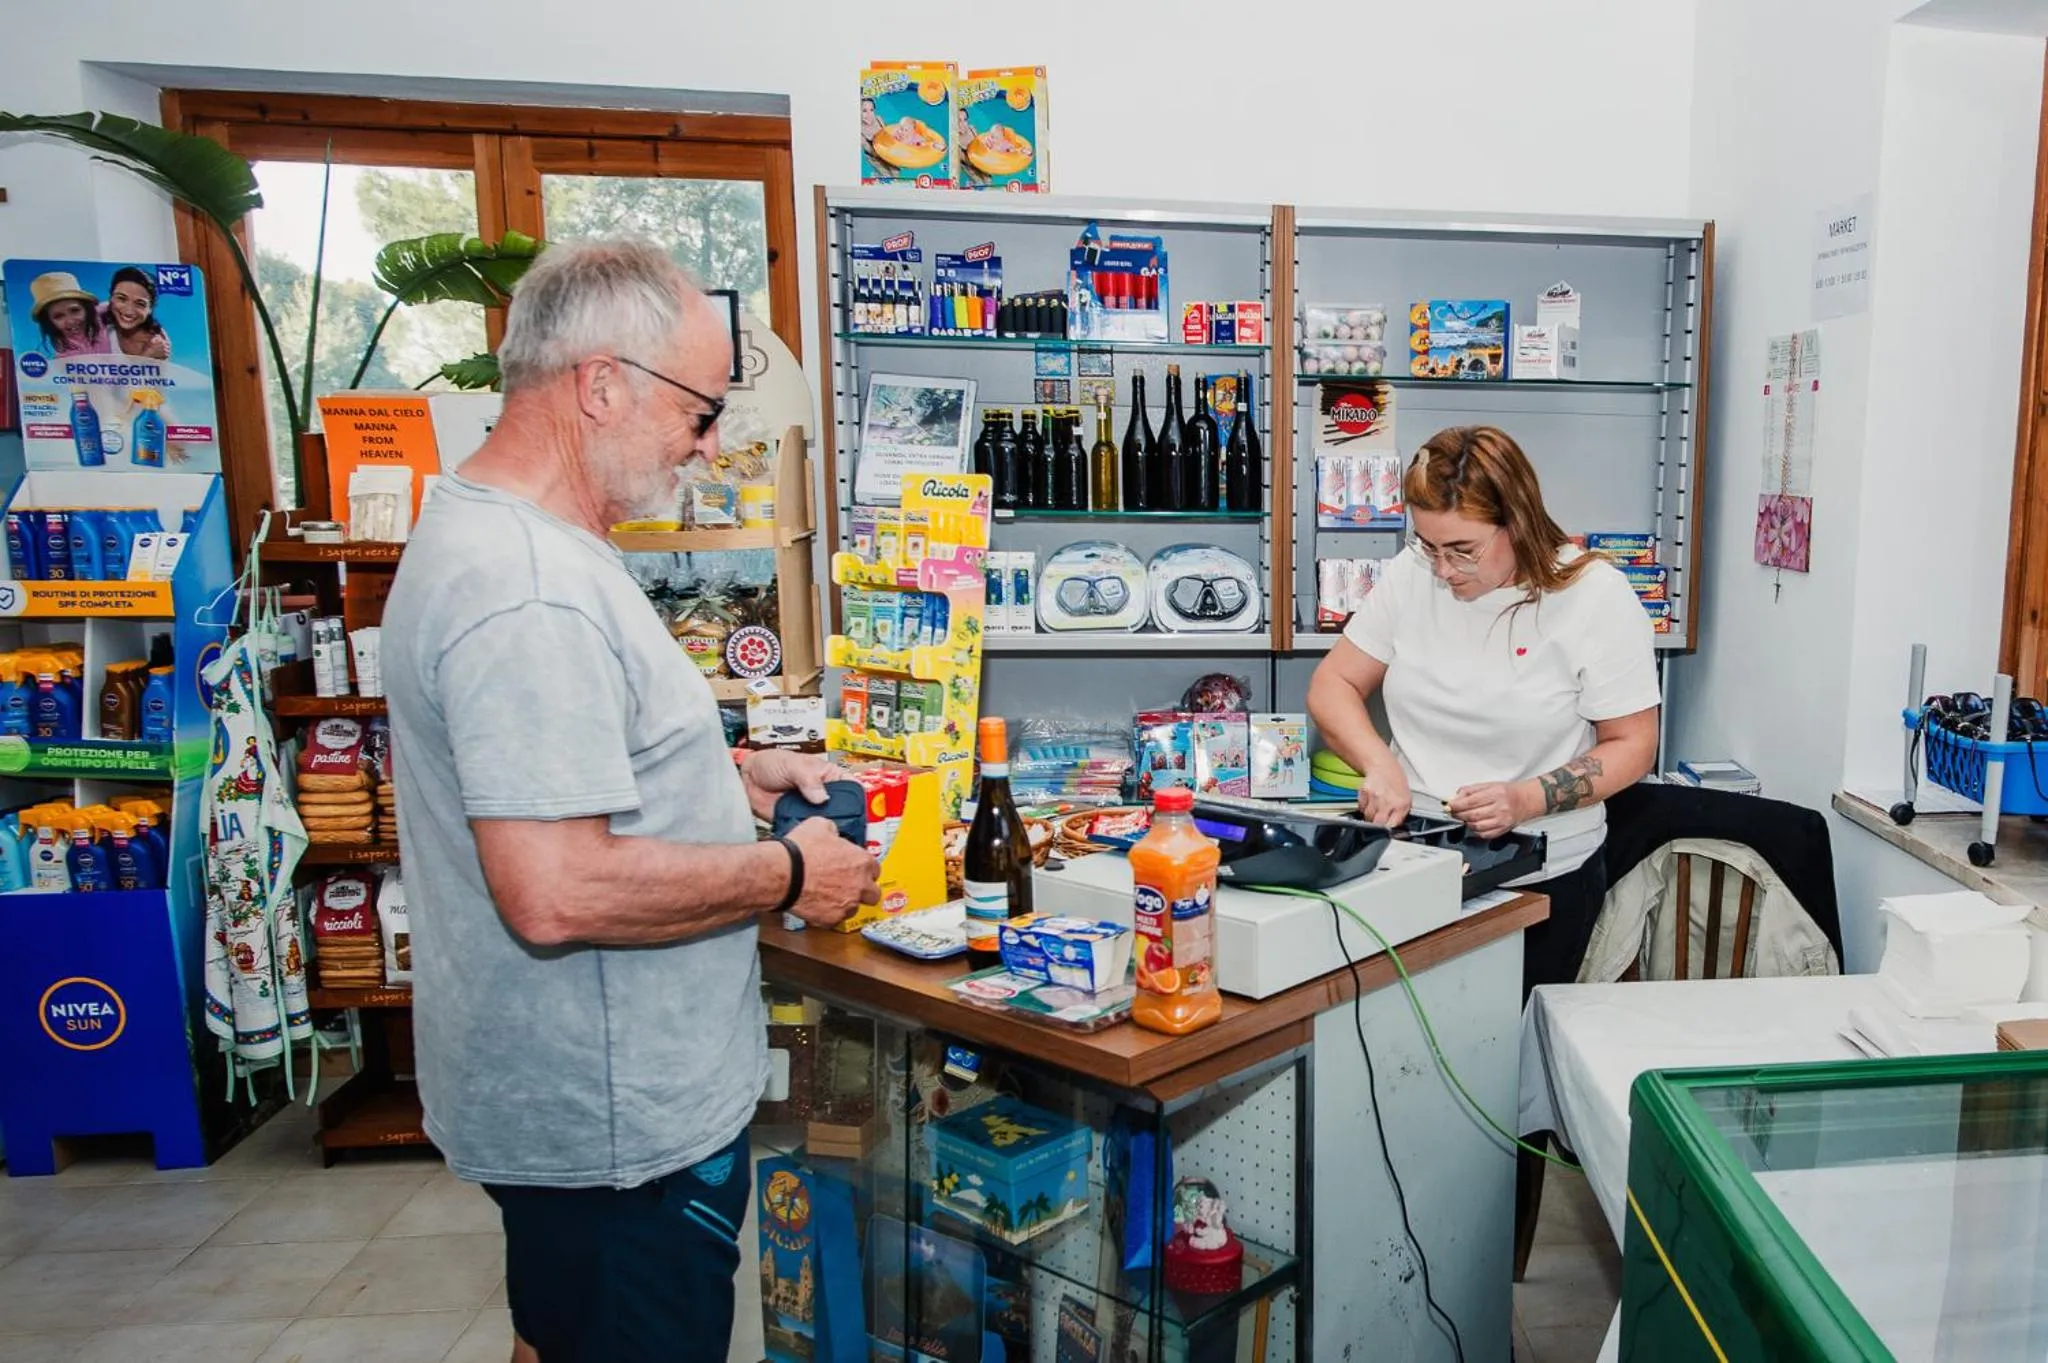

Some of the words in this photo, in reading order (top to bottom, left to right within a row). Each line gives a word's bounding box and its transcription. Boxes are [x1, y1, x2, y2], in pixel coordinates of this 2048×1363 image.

[66, 363, 160, 377] PROTEGGITI
[53, 376, 75, 384] CON
[78, 377, 87, 385] IL
[89, 377, 128, 385] MEGLIO
[131, 378, 142, 386] DI
[145, 378, 175, 386] NIVEA
[322, 408, 366, 417] MANNA
[369, 409, 389, 417] DAL
[393, 409, 425, 417] CIELO
[1331, 407, 1377, 422] MIKADO
[354, 423, 398, 432] MANNA
[362, 436, 394, 444] FROM
[360, 450, 403, 458] HEAVEN
[922, 479, 969, 498] Ricola
[48, 568, 65, 579] 30
[32, 590, 76, 598] ROUTINE
[47, 747, 123, 759] PROTEZIONE
[126, 750, 150, 759] PER
[41, 757, 71, 766] OGNI
[72, 758, 102, 768] TIPO
[105, 760, 117, 768] DI
[120, 760, 157, 770] PELLE
[310, 750, 352, 769] pastine
[323, 911, 364, 931] riccioli
[51, 1002, 116, 1018] NIVEA
[66, 1019, 102, 1031] SUN
